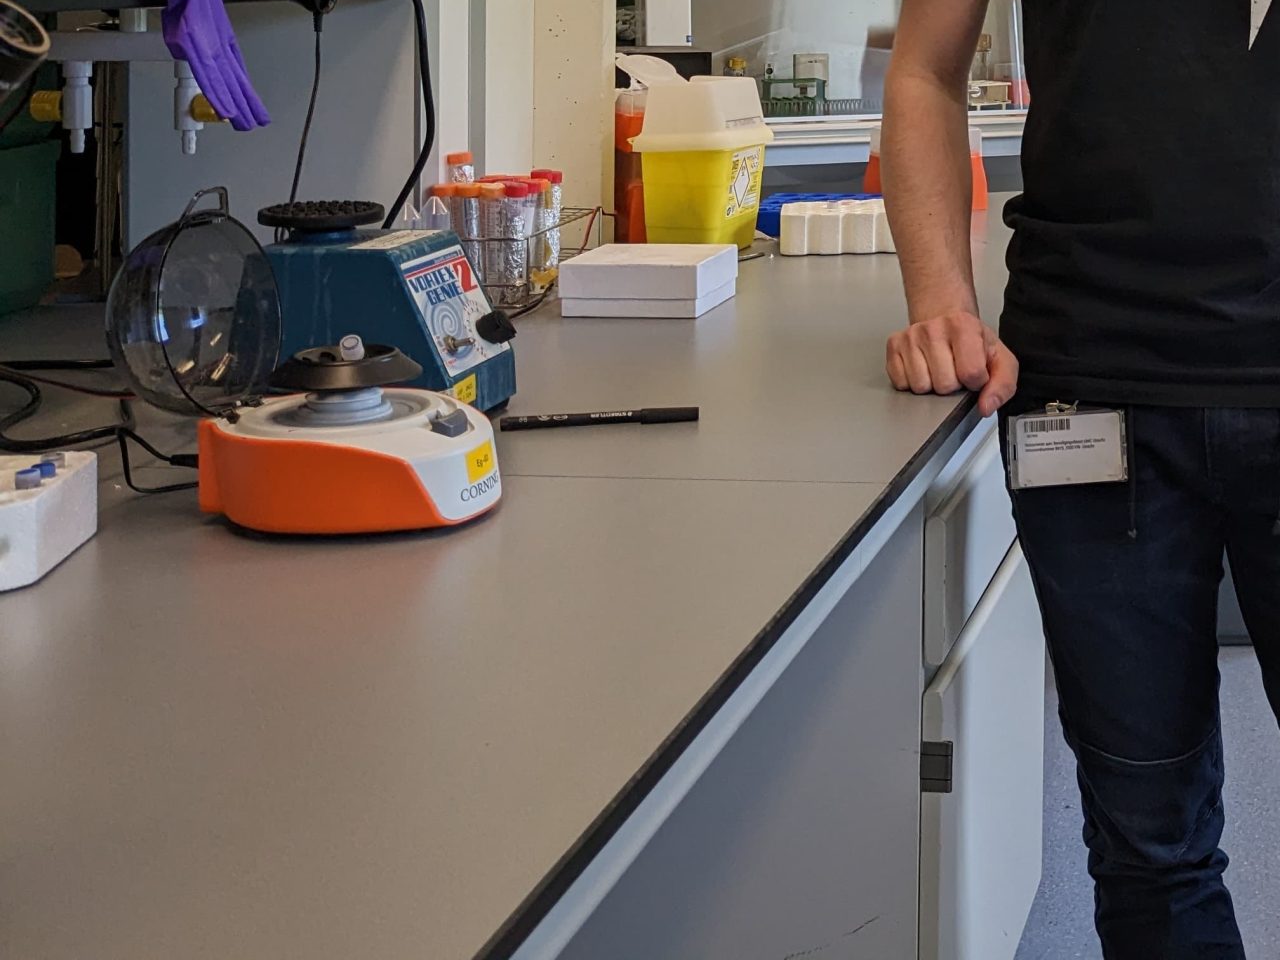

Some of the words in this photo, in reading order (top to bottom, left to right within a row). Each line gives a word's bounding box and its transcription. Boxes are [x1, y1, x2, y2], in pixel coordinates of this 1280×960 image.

[407, 266, 456, 293] VORTEX
[426, 281, 463, 305] GENIE
[452, 259, 478, 292] 2
